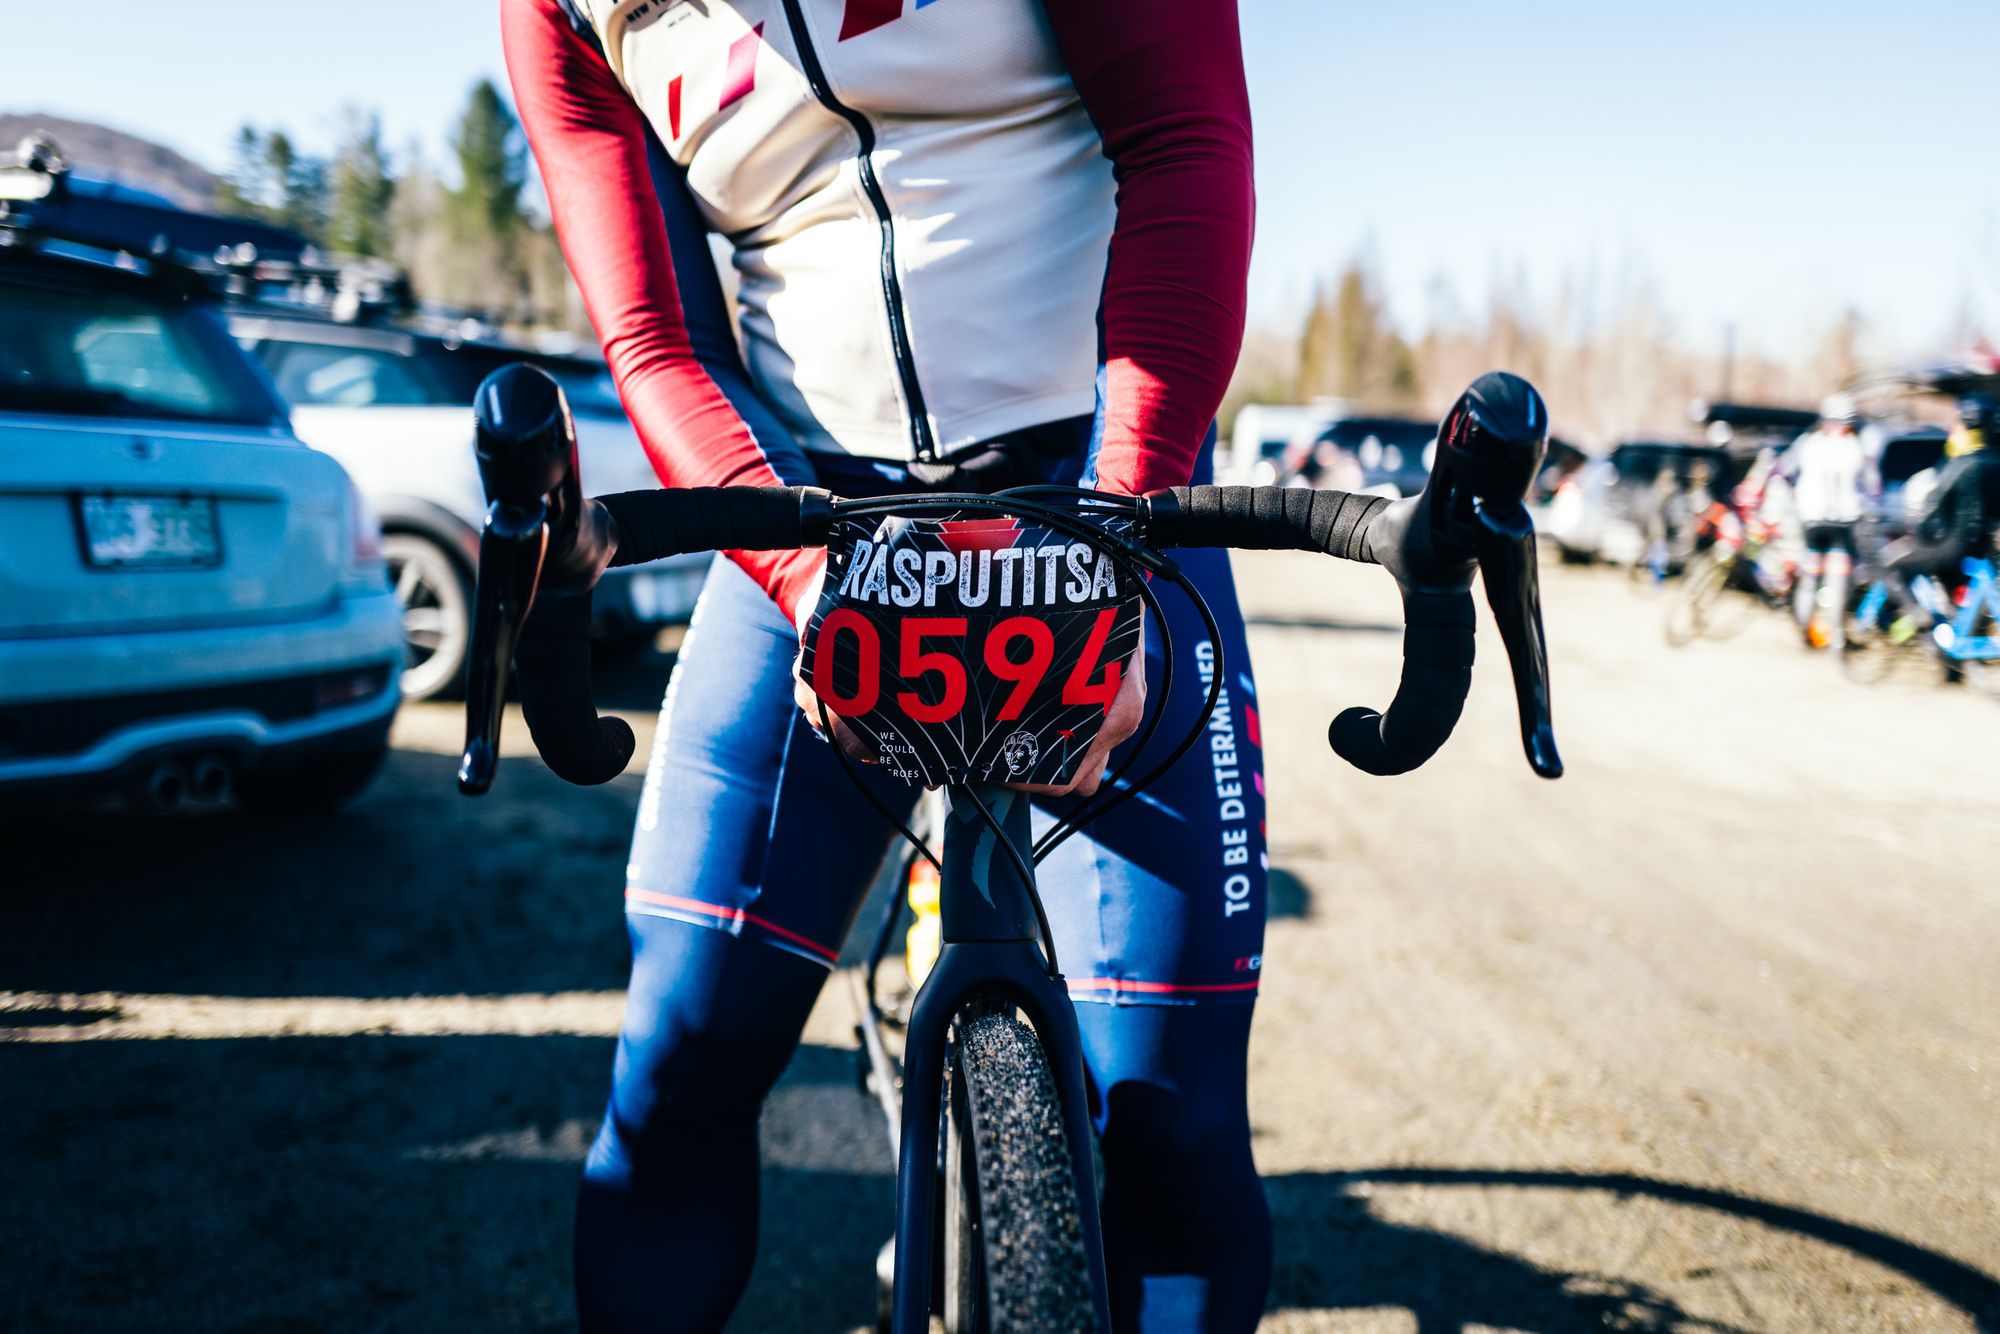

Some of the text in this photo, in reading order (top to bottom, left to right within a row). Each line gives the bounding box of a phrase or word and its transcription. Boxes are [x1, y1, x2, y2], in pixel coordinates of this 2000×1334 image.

[839, 539, 1117, 607] RASPUTITSA
[813, 608, 1122, 723] 0594
[880, 731, 896, 741] WE
[880, 744, 915, 754] COULD
[880, 756, 892, 765] BE
[887, 768, 919, 778] ROES
[1223, 828, 1249, 866] BE
[1225, 874, 1251, 917] TO
